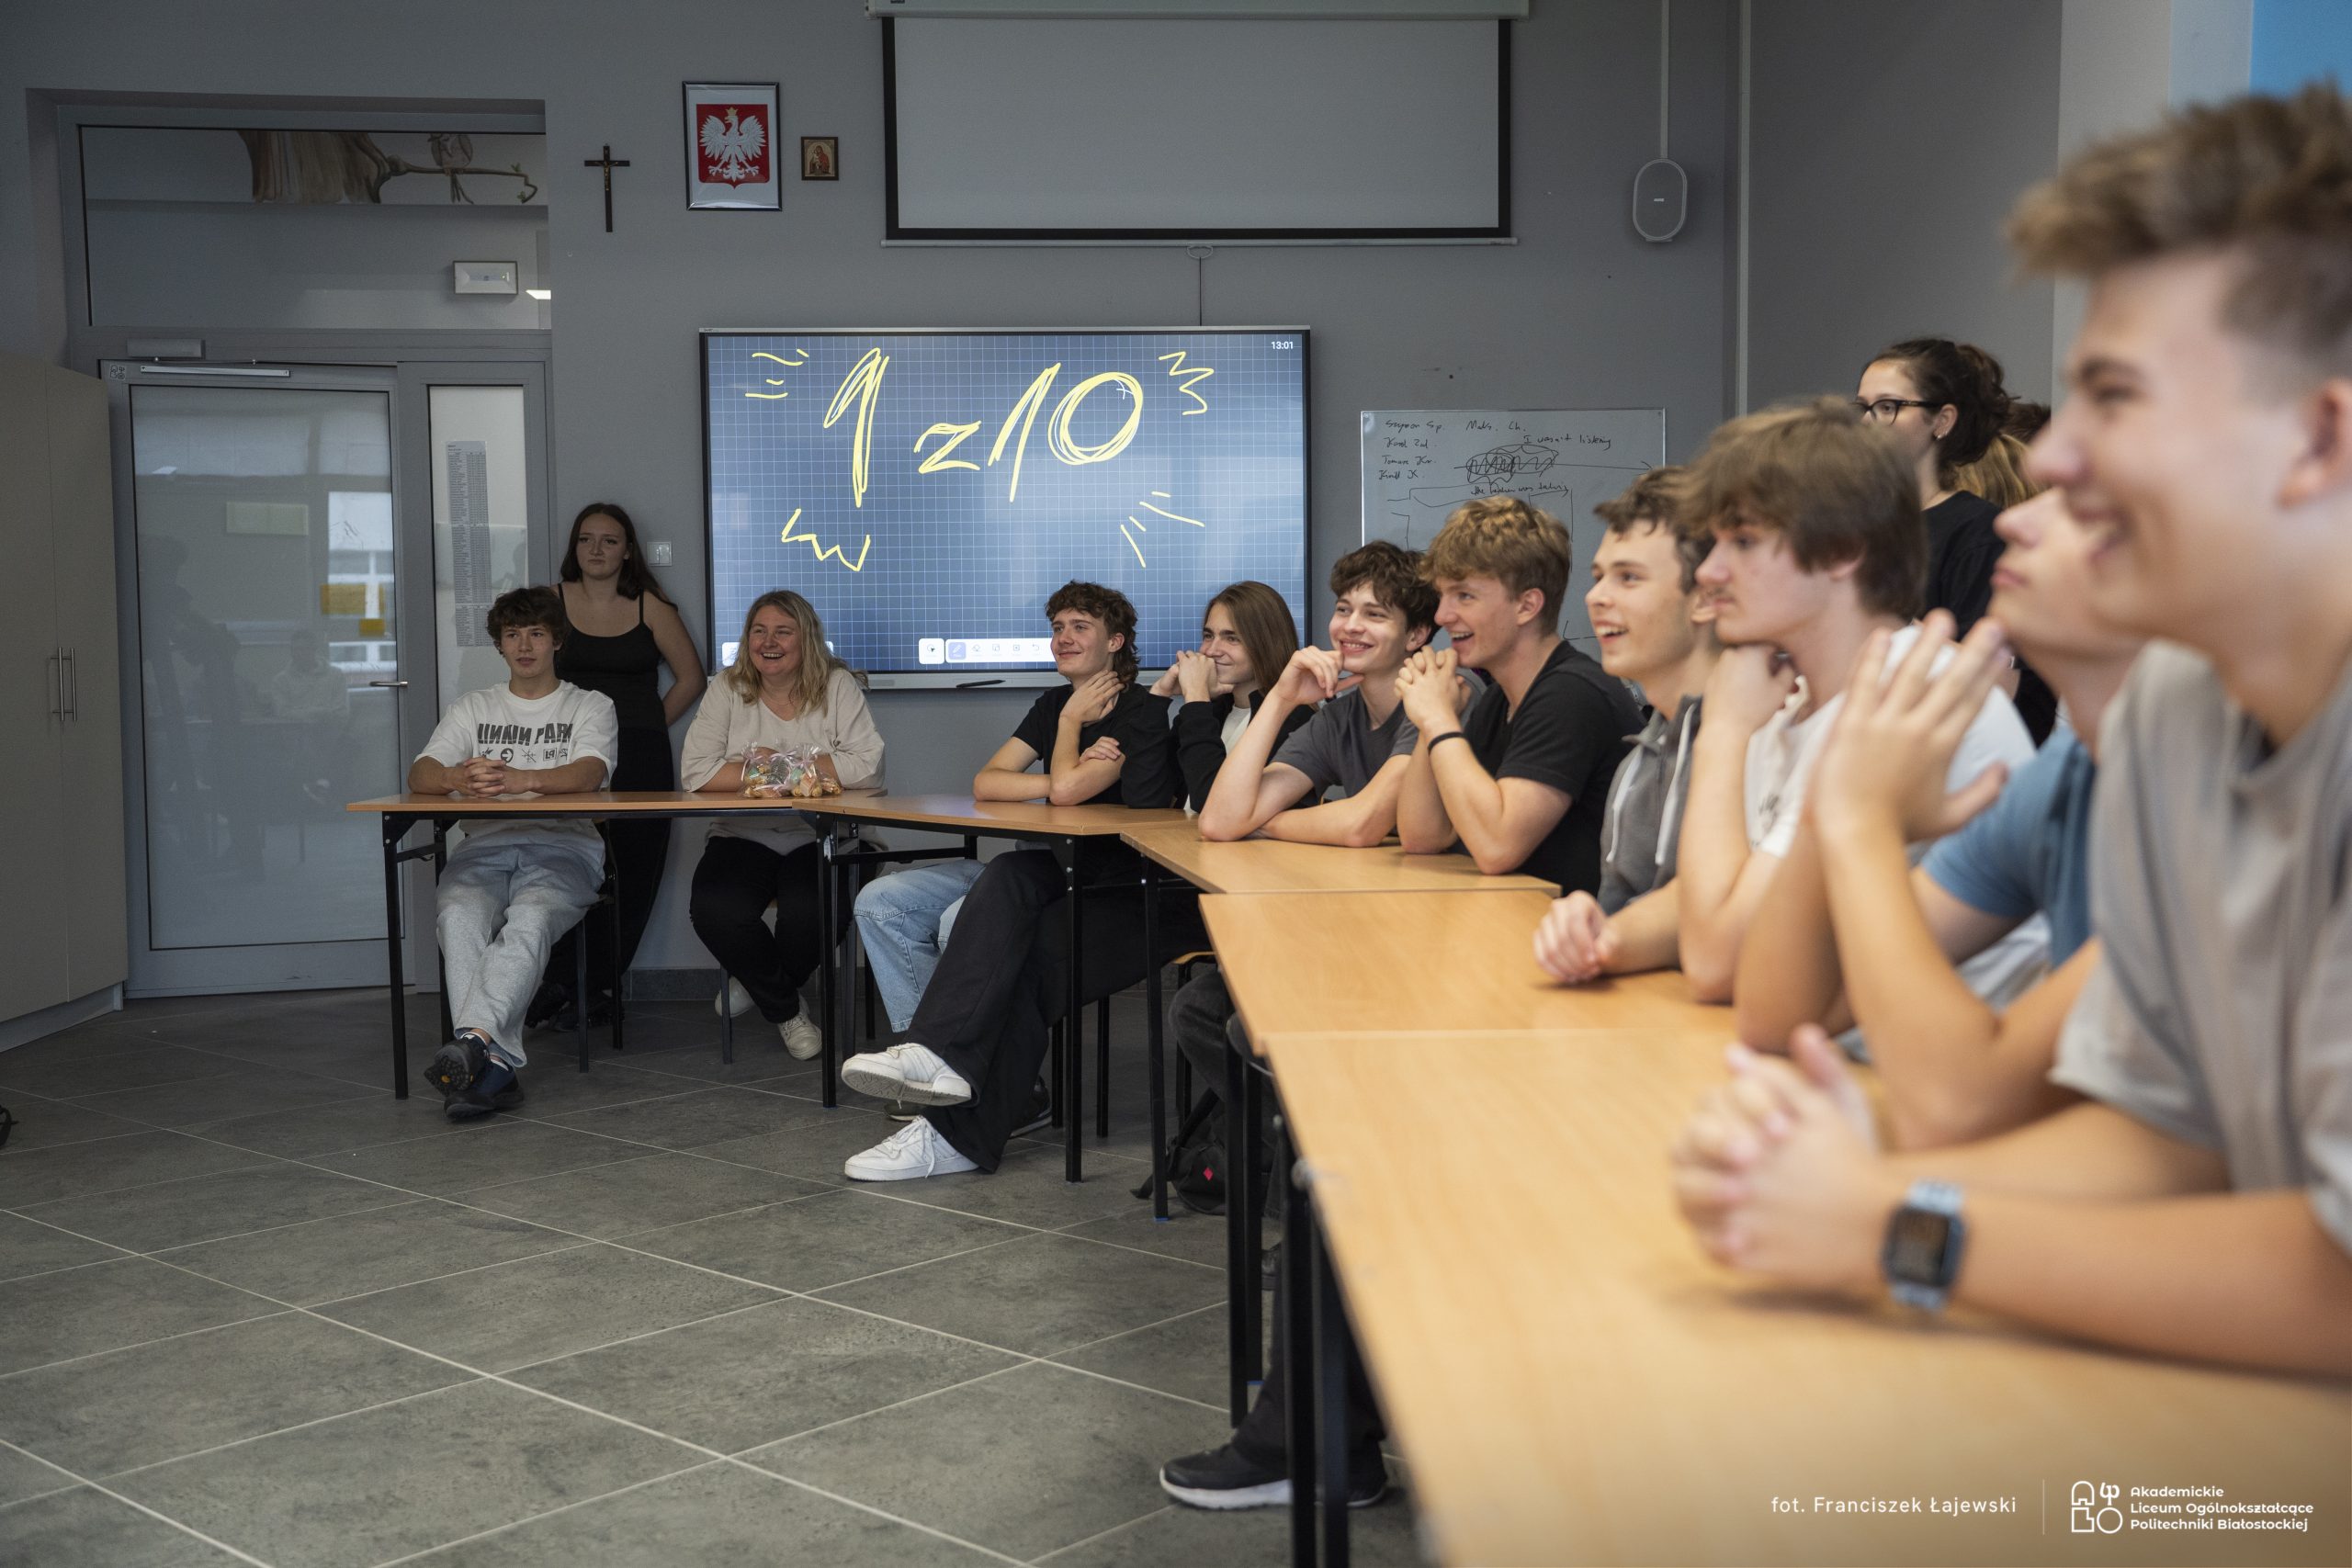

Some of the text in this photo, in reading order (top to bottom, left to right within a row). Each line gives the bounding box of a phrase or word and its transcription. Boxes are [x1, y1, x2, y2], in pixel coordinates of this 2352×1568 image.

[1271, 341, 1294, 350] 13:01
[914, 420, 981, 474] z
[988, 362, 1144, 502] 10
[1523, 434, 1532, 445] I
[478, 723, 533, 746] LINKIN
